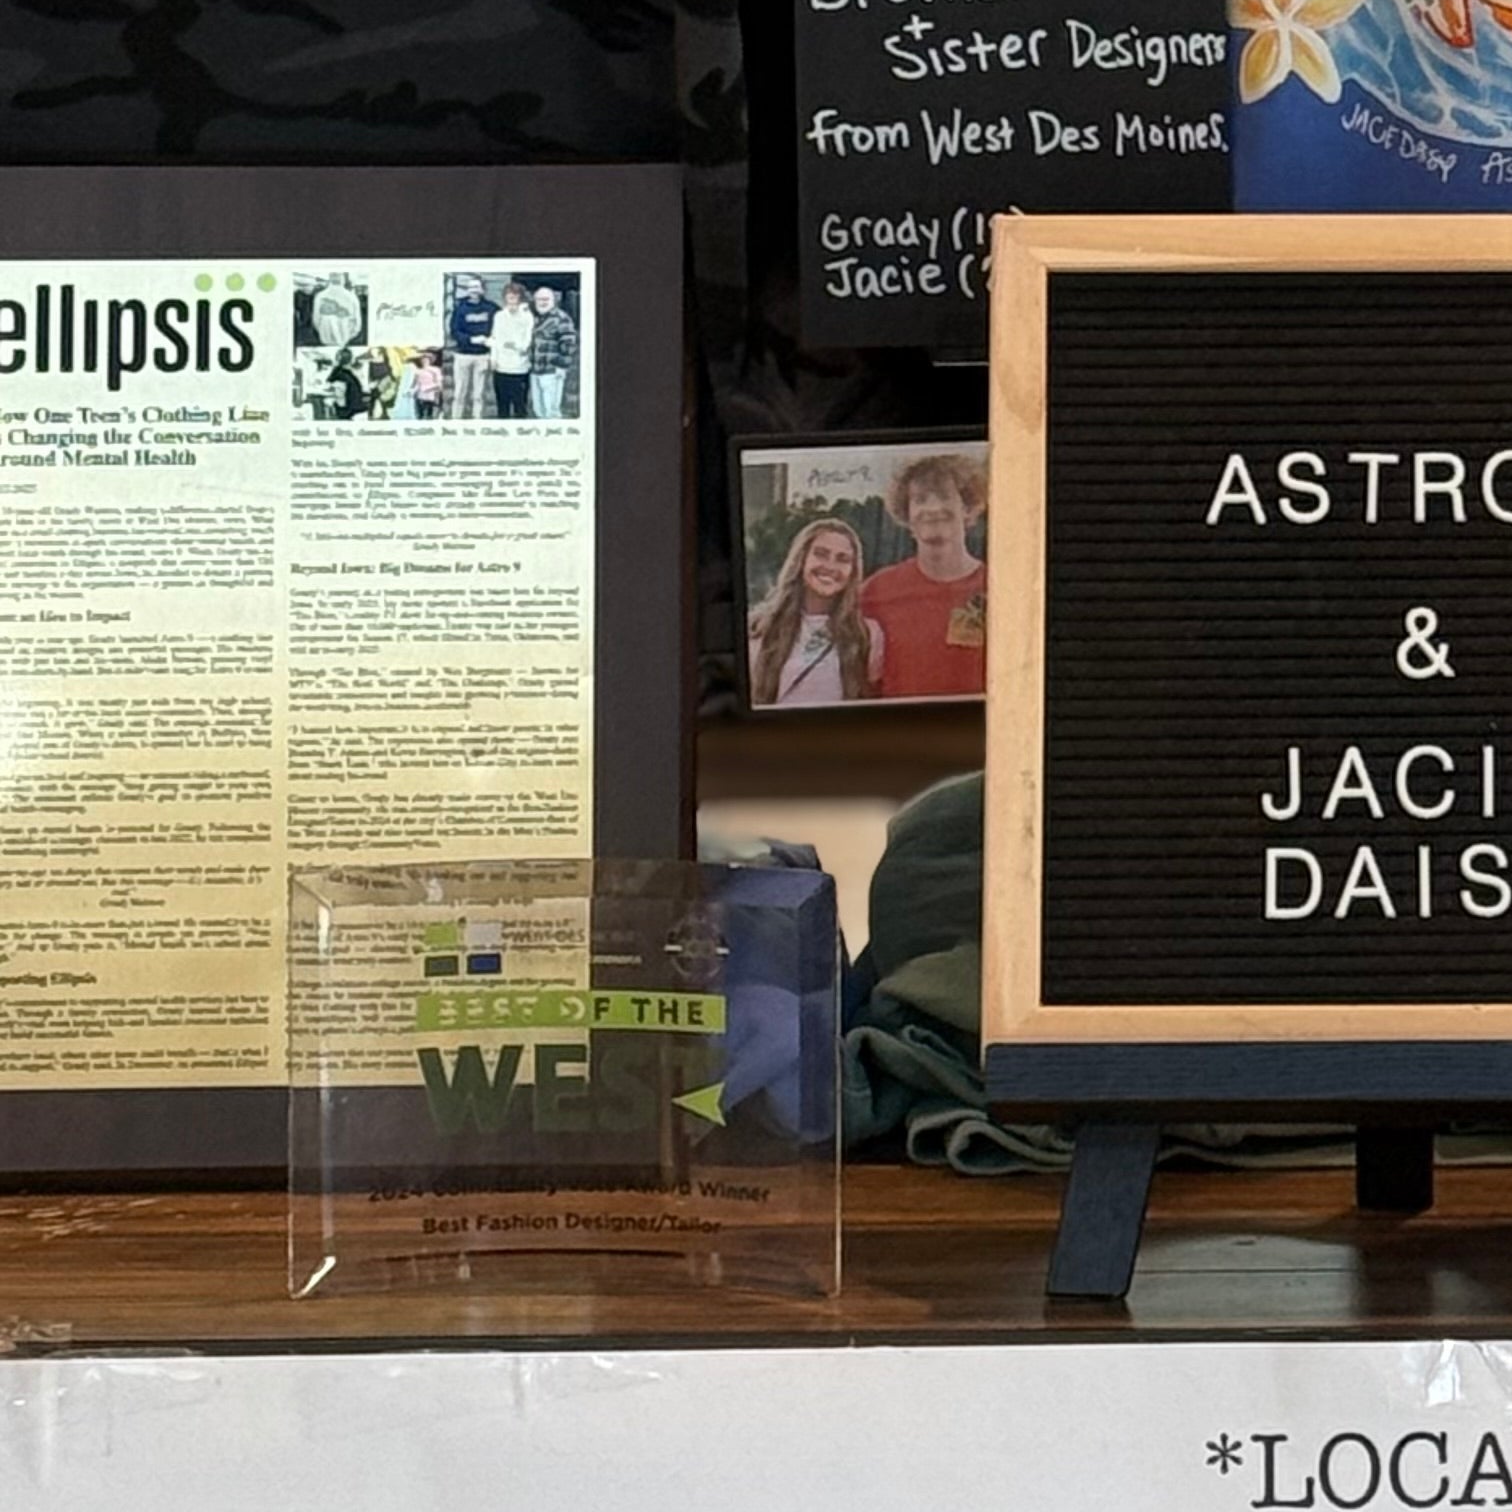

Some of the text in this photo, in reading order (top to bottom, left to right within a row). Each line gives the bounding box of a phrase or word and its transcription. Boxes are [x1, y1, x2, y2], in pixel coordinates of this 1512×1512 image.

[884, 29, 1048, 80] Sister
[1066, 18, 1228, 86] Designers
[807, 109, 1229, 165] from West Des Moines.
[821, 211, 939, 259] Grady
[824, 256, 946, 298] Jacie
[0, 284, 255, 392] ellipsis
[34, 407, 73, 424] One
[77, 407, 136, 424] Teen's
[142, 405, 222, 426] Clothing
[228, 406, 270, 423] Line
[8, 428, 261, 448] Changing the Conversation
[0, 450, 196, 466] round Mental Health
[1396, 606, 1455, 679] &
[437, 996, 539, 1025] BEST
[559, 996, 611, 1022] OF
[631, 998, 705, 1025] THE
[699, 1181, 771, 1203] Winner
[421, 1212, 722, 1235] Best Fashion Designer/Tailor
